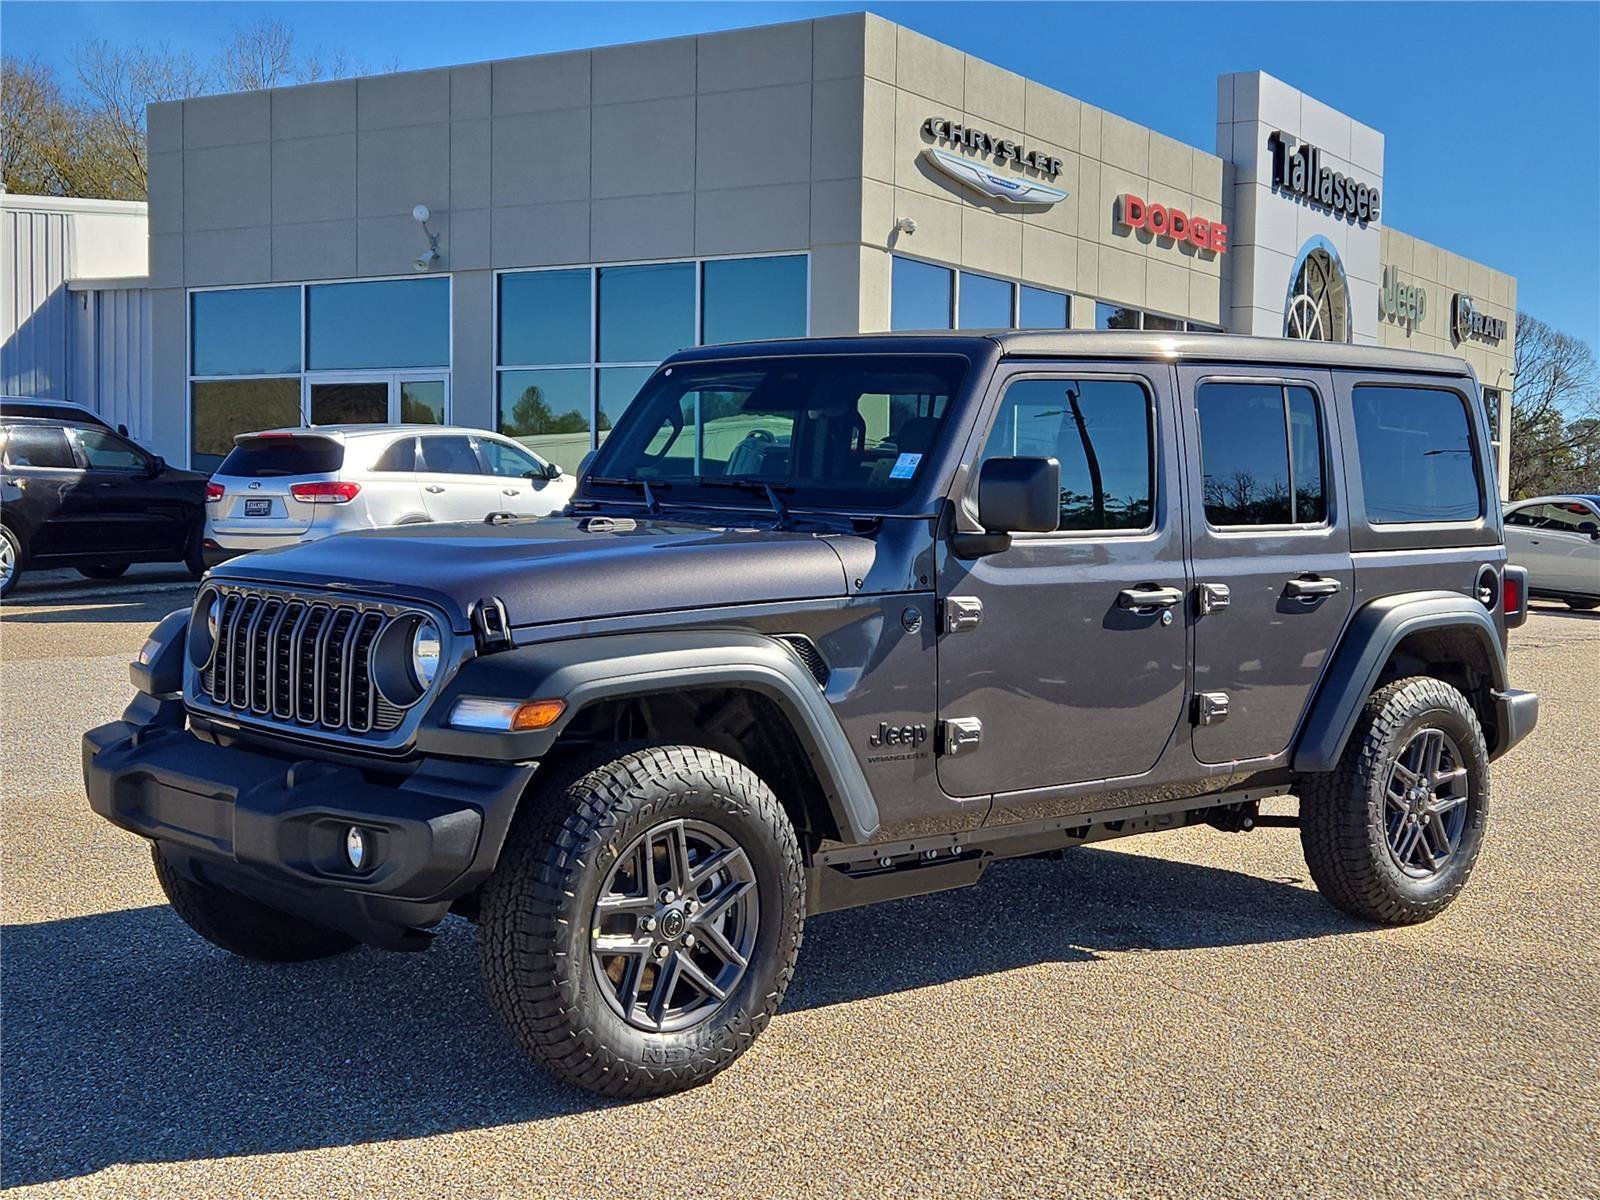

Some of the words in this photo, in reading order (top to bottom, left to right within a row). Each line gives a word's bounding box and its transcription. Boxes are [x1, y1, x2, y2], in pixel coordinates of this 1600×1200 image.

[926, 115, 1064, 177] CHRYSLER
[1276, 130, 1380, 222] Tallassee
[1122, 193, 1228, 254] DODGE
[1382, 264, 1427, 331] Jeep
[1471, 310, 1508, 341] RAM
[867, 751, 919, 763] WRANGLER
[869, 721, 928, 748] Jeep
